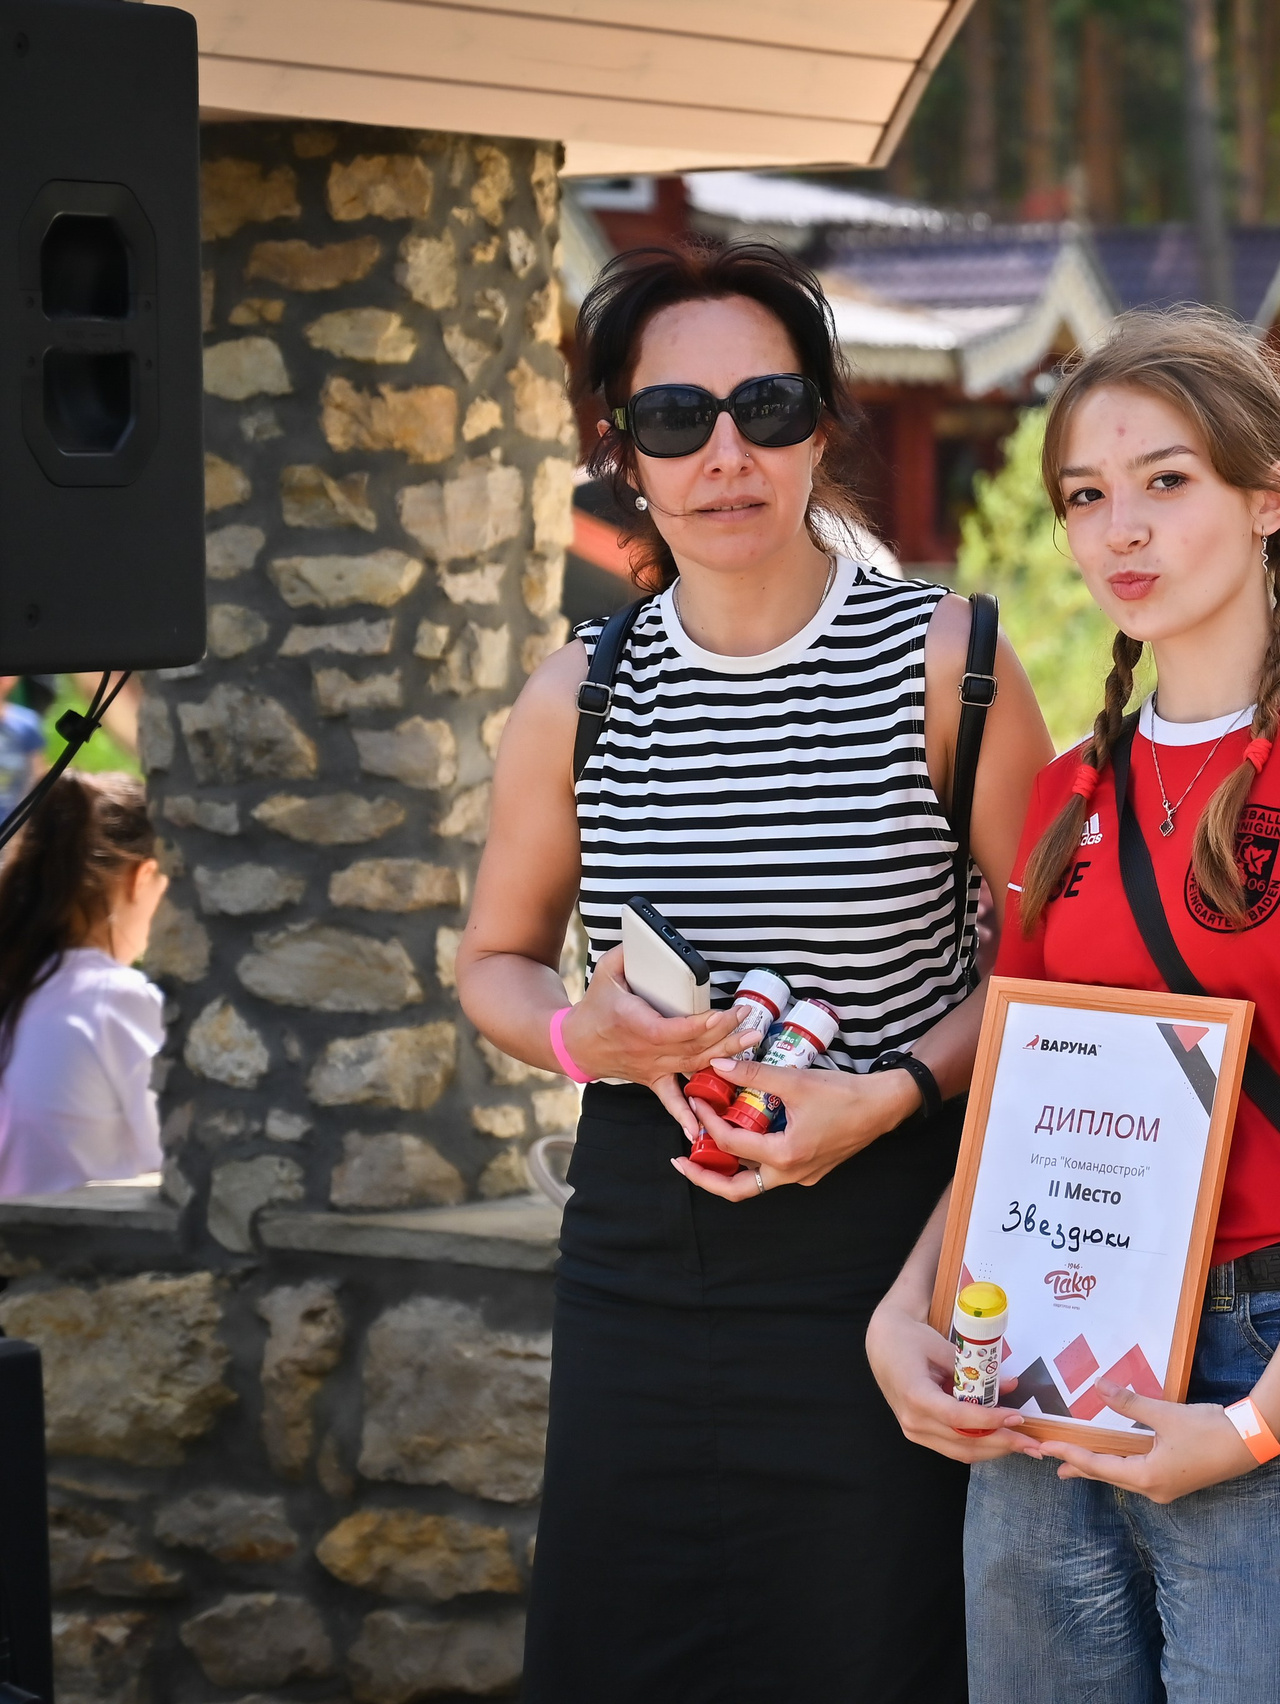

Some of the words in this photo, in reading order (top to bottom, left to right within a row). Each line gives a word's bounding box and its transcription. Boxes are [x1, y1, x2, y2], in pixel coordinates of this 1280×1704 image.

[1247, 879, 1280, 921] BADEN
[1040, 1039, 1098, 1056] ВАРУНА
[1034, 1105, 1161, 1142] ДИПЛОМ
[1030, 1153, 1057, 1169] Игра
[1060, 1156, 1151, 1178] "Командострой"
[1048, 1180, 1060, 1198] II
[1064, 1181, 1122, 1205] Место
[1002, 1201, 1131, 1252] Звездюки
